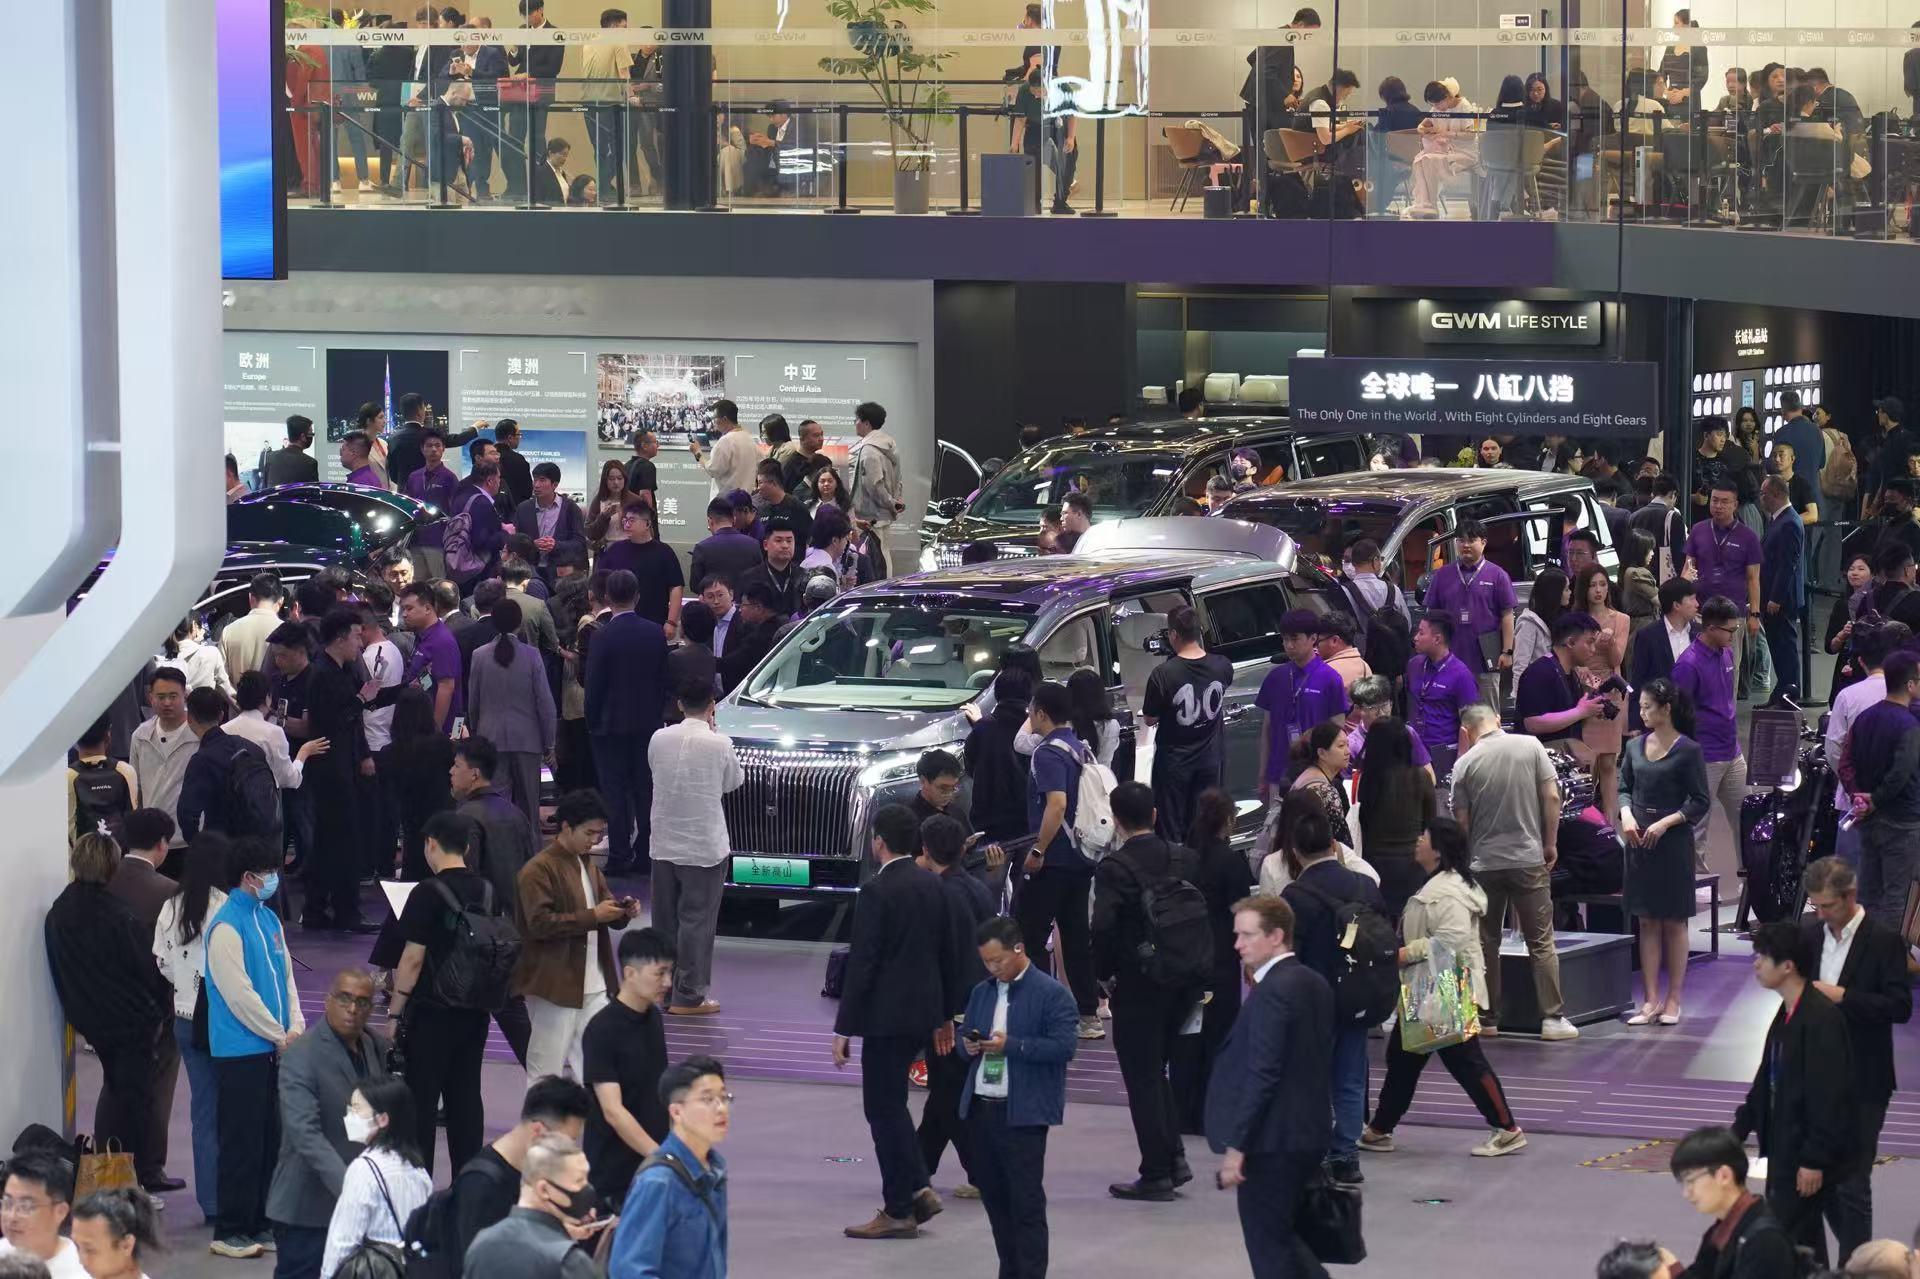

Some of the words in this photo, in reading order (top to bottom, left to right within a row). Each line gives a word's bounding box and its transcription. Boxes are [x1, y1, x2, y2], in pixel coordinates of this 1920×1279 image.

[287, 33, 307, 41] WM
[372, 33, 404, 41] GWM
[670, 32, 704, 41] GWM
[773, 32, 807, 41] GWM
[980, 32, 1016, 41] GWM
[1414, 32, 1452, 41] GWM
[1515, 32, 1553, 41] GWM
[1431, 312, 1500, 329] GWM
[239, 352, 270, 368] 欧洲
[507, 357, 539, 374] 澳洲
[784, 363, 817, 380] 中亚
[241, 372, 267, 381] Europe
[508, 378, 539, 386] Australia
[1361, 371, 1459, 400] 全球唯一
[1473, 373, 1574, 402] 八缸八挡
[779, 384, 805, 393] Central
[805, 385, 822, 393] Asia
[1297, 408, 1317, 420] The
[1320, 409, 1344, 423] Only
[1347, 409, 1368, 420] One
[1371, 410, 1381, 421] in
[1384, 410, 1402, 421] the
[1445, 411, 1473, 422] With
[1475, 412, 1504, 425] Eight
[1507, 412, 1558, 425] Cylinders
[1560, 413, 1580, 424] and
[1583, 413, 1612, 427] Eight
[1615, 414, 1647, 426] Gears
[656, 497, 678, 515] 美
[1172, 680, 1224, 726] 10
[751, 864, 792, 878] 全新高山
